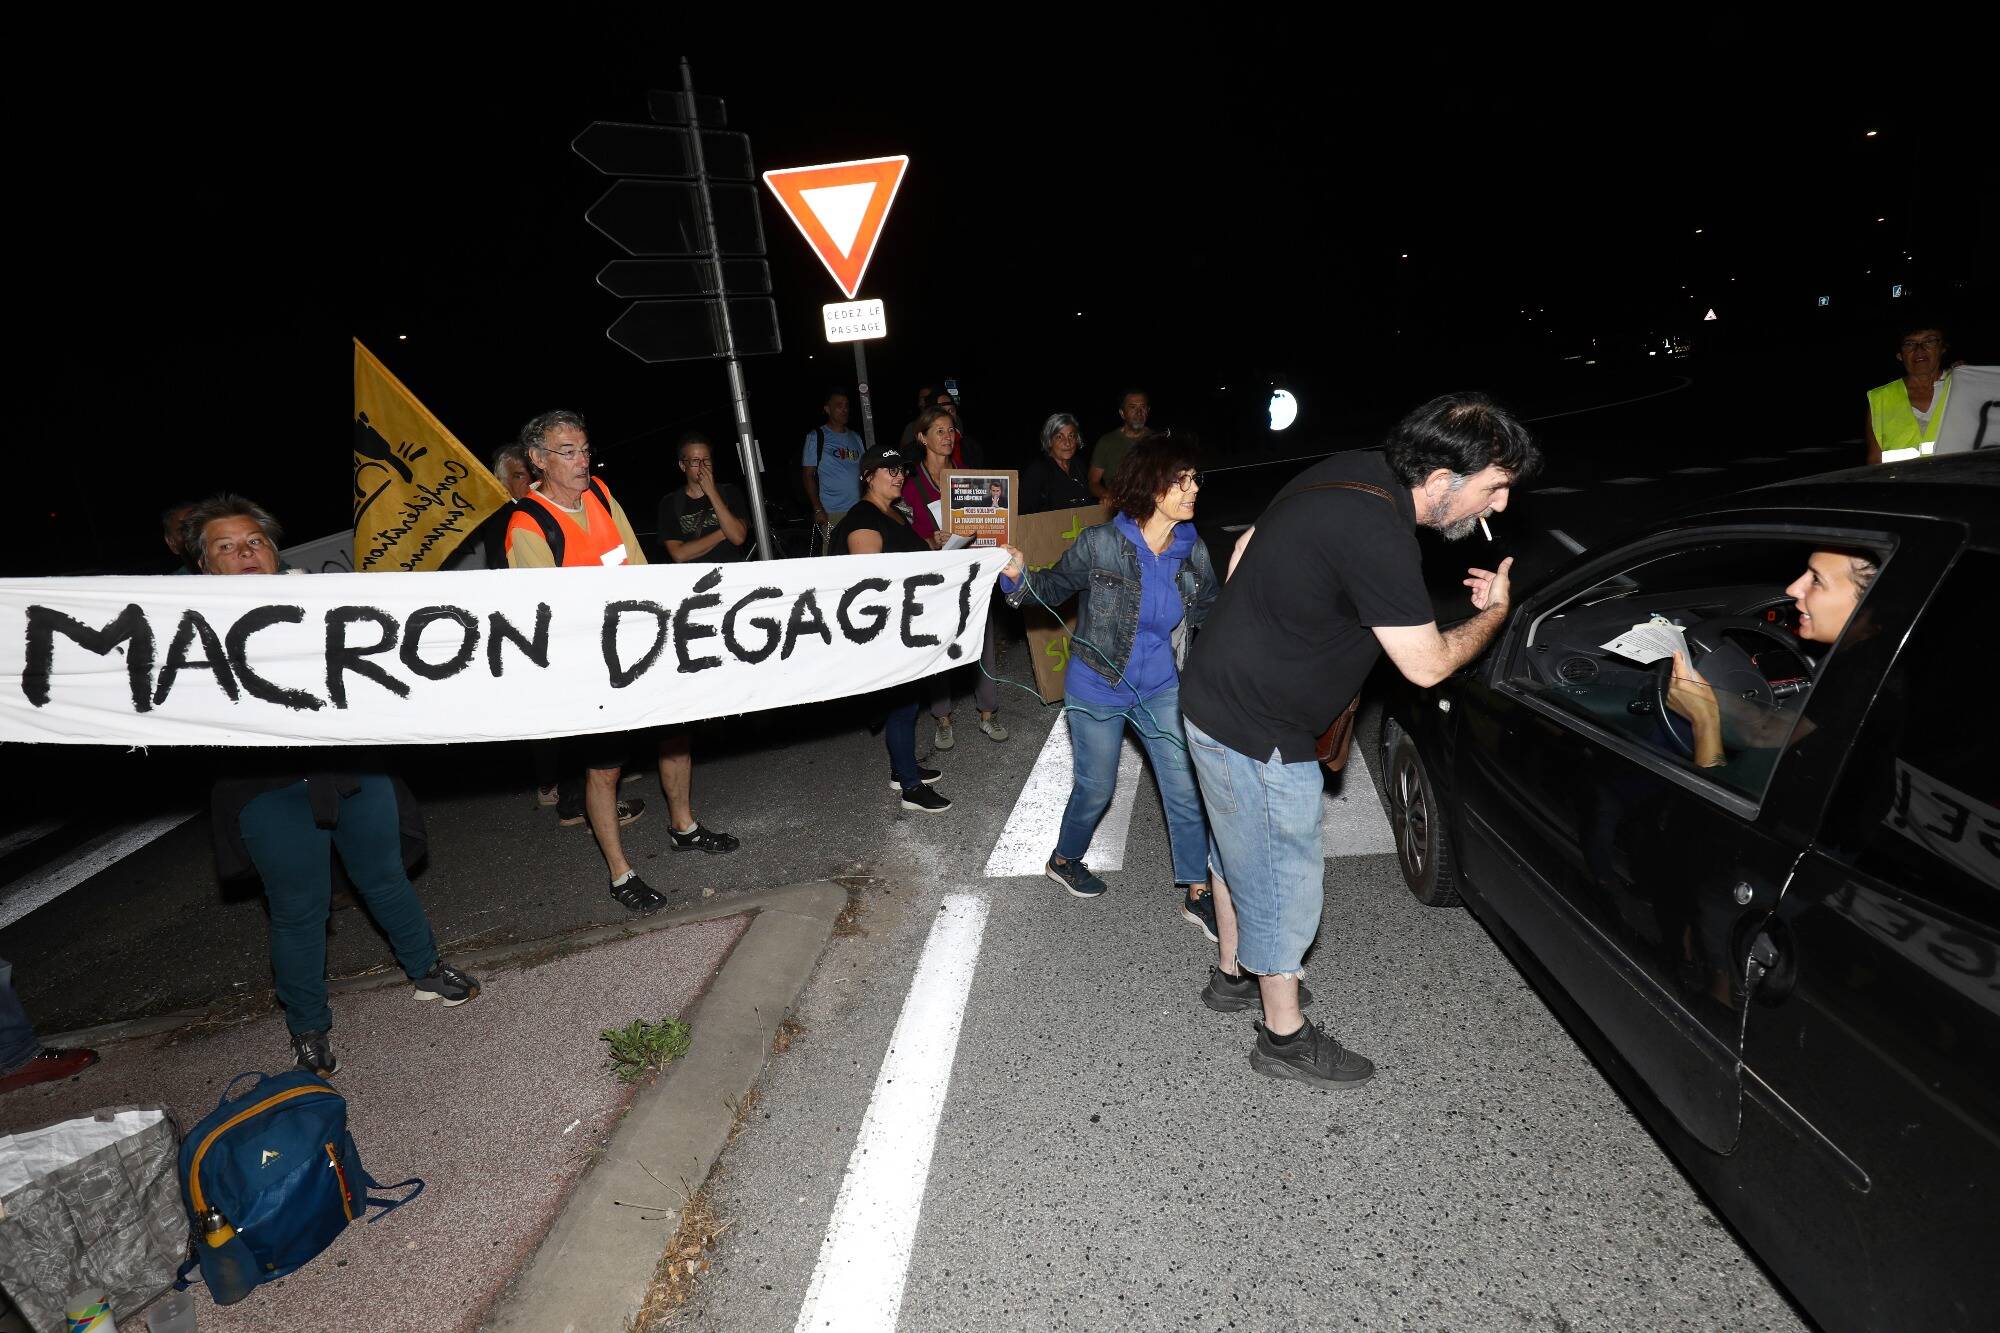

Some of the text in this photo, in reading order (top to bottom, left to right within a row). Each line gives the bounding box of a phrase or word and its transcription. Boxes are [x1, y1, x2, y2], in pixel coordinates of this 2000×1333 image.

[870, 307, 880, 315] LE
[831, 322, 880, 334] PASSAGE
[22, 567, 982, 712] MACRON DÉGAGE!
